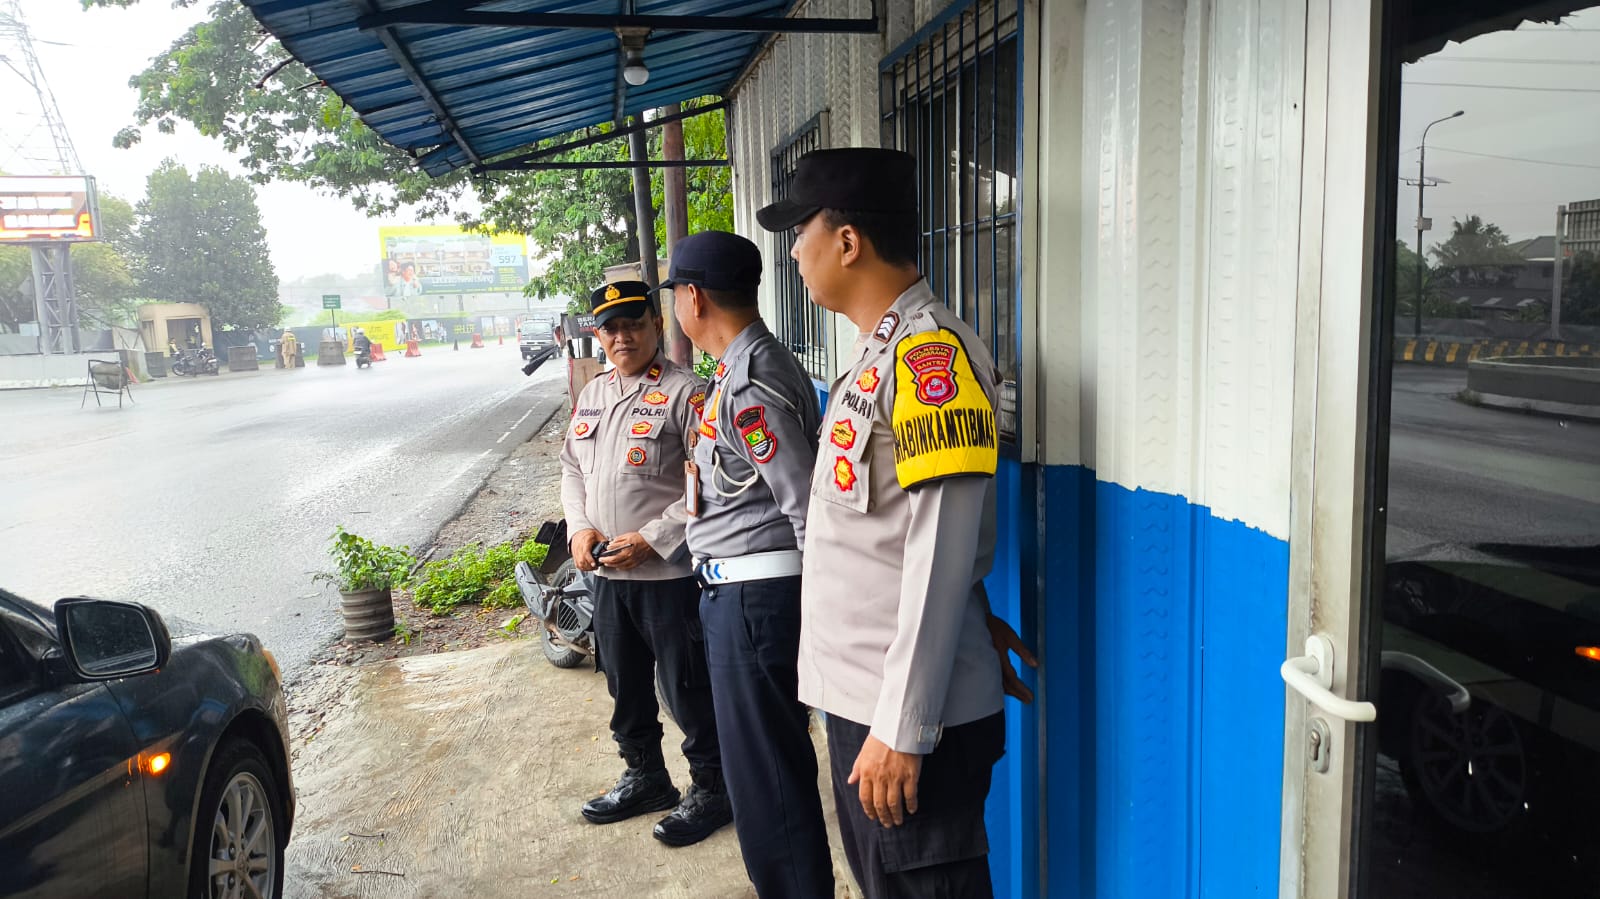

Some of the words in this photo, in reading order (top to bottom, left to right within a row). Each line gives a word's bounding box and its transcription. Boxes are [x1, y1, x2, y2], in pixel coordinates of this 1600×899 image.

[916, 360, 946, 370] BANTEN
[631, 407, 666, 417] POLRI
[841, 390, 873, 419] POLRI
[893, 407, 995, 465] HABINKAMTIBMAS
